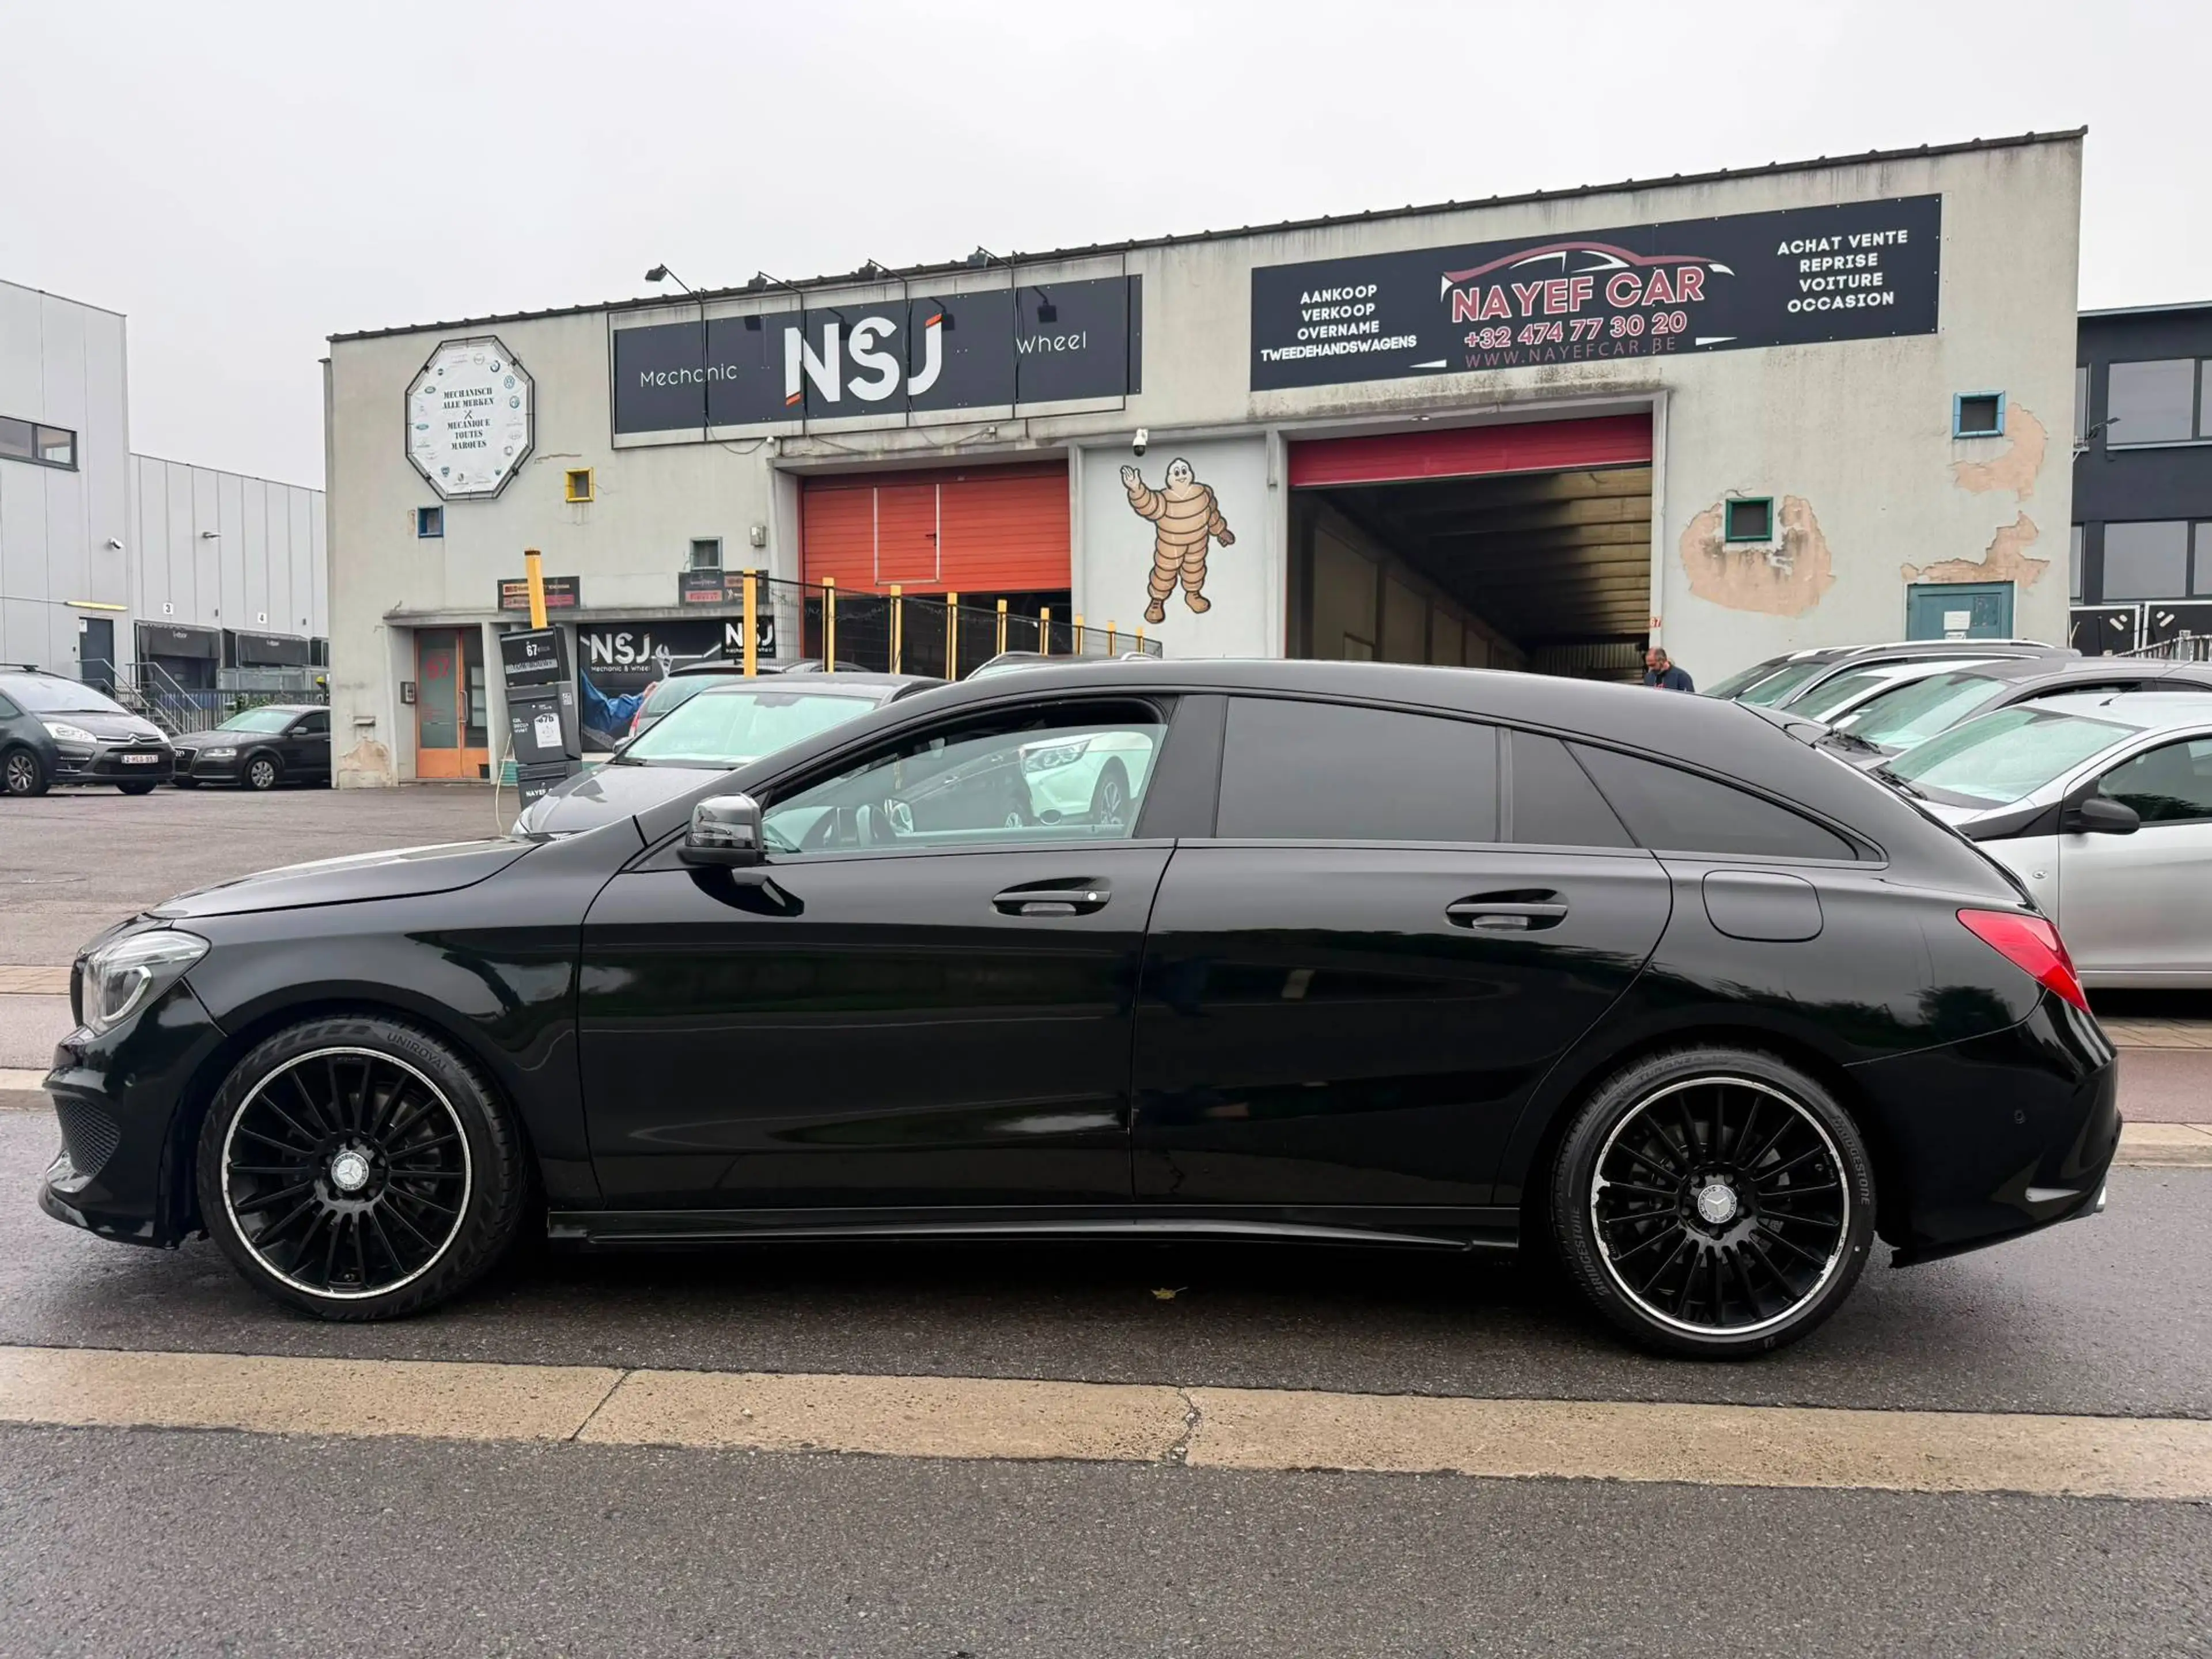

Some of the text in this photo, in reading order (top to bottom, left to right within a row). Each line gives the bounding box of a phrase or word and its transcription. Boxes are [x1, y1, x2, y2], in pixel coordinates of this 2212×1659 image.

[1777, 230, 1908, 256] ACHAT VENTE
[1800, 253, 1878, 273] REPRISE
[1800, 272, 1883, 293] VOITURE
[1300, 285, 1377, 305] AANKOOP
[1452, 266, 1705, 323] NAYEF CAR
[1787, 291, 1894, 313] OCCASION
[1302, 302, 1376, 321] VERKOOP
[1297, 320, 1380, 340] OVERNAME
[1465, 311, 1687, 349] +32 474 77 30 20
[1017, 331, 1086, 355] Wheel
[1261, 335, 1416, 362] TWEEDEHANDSWAGENS
[785, 313, 943, 406] NSJ
[640, 363, 737, 388] Mechanic
[442, 397, 494, 409] ALLE MERKEN
[444, 387, 493, 399] MECHANISCH
[451, 440, 487, 450] MARQUES
[454, 430, 483, 440] TOUTES
[166, 604, 171, 613] 3
[527, 644, 537, 657] 67
[591, 632, 650, 664] NSJ
[388, 1032, 448, 1071] UNIROYAL
[1831, 1115, 1871, 1206] BRIDGESTONE
[1570, 1206, 1611, 1296] BRIDGESTONE
